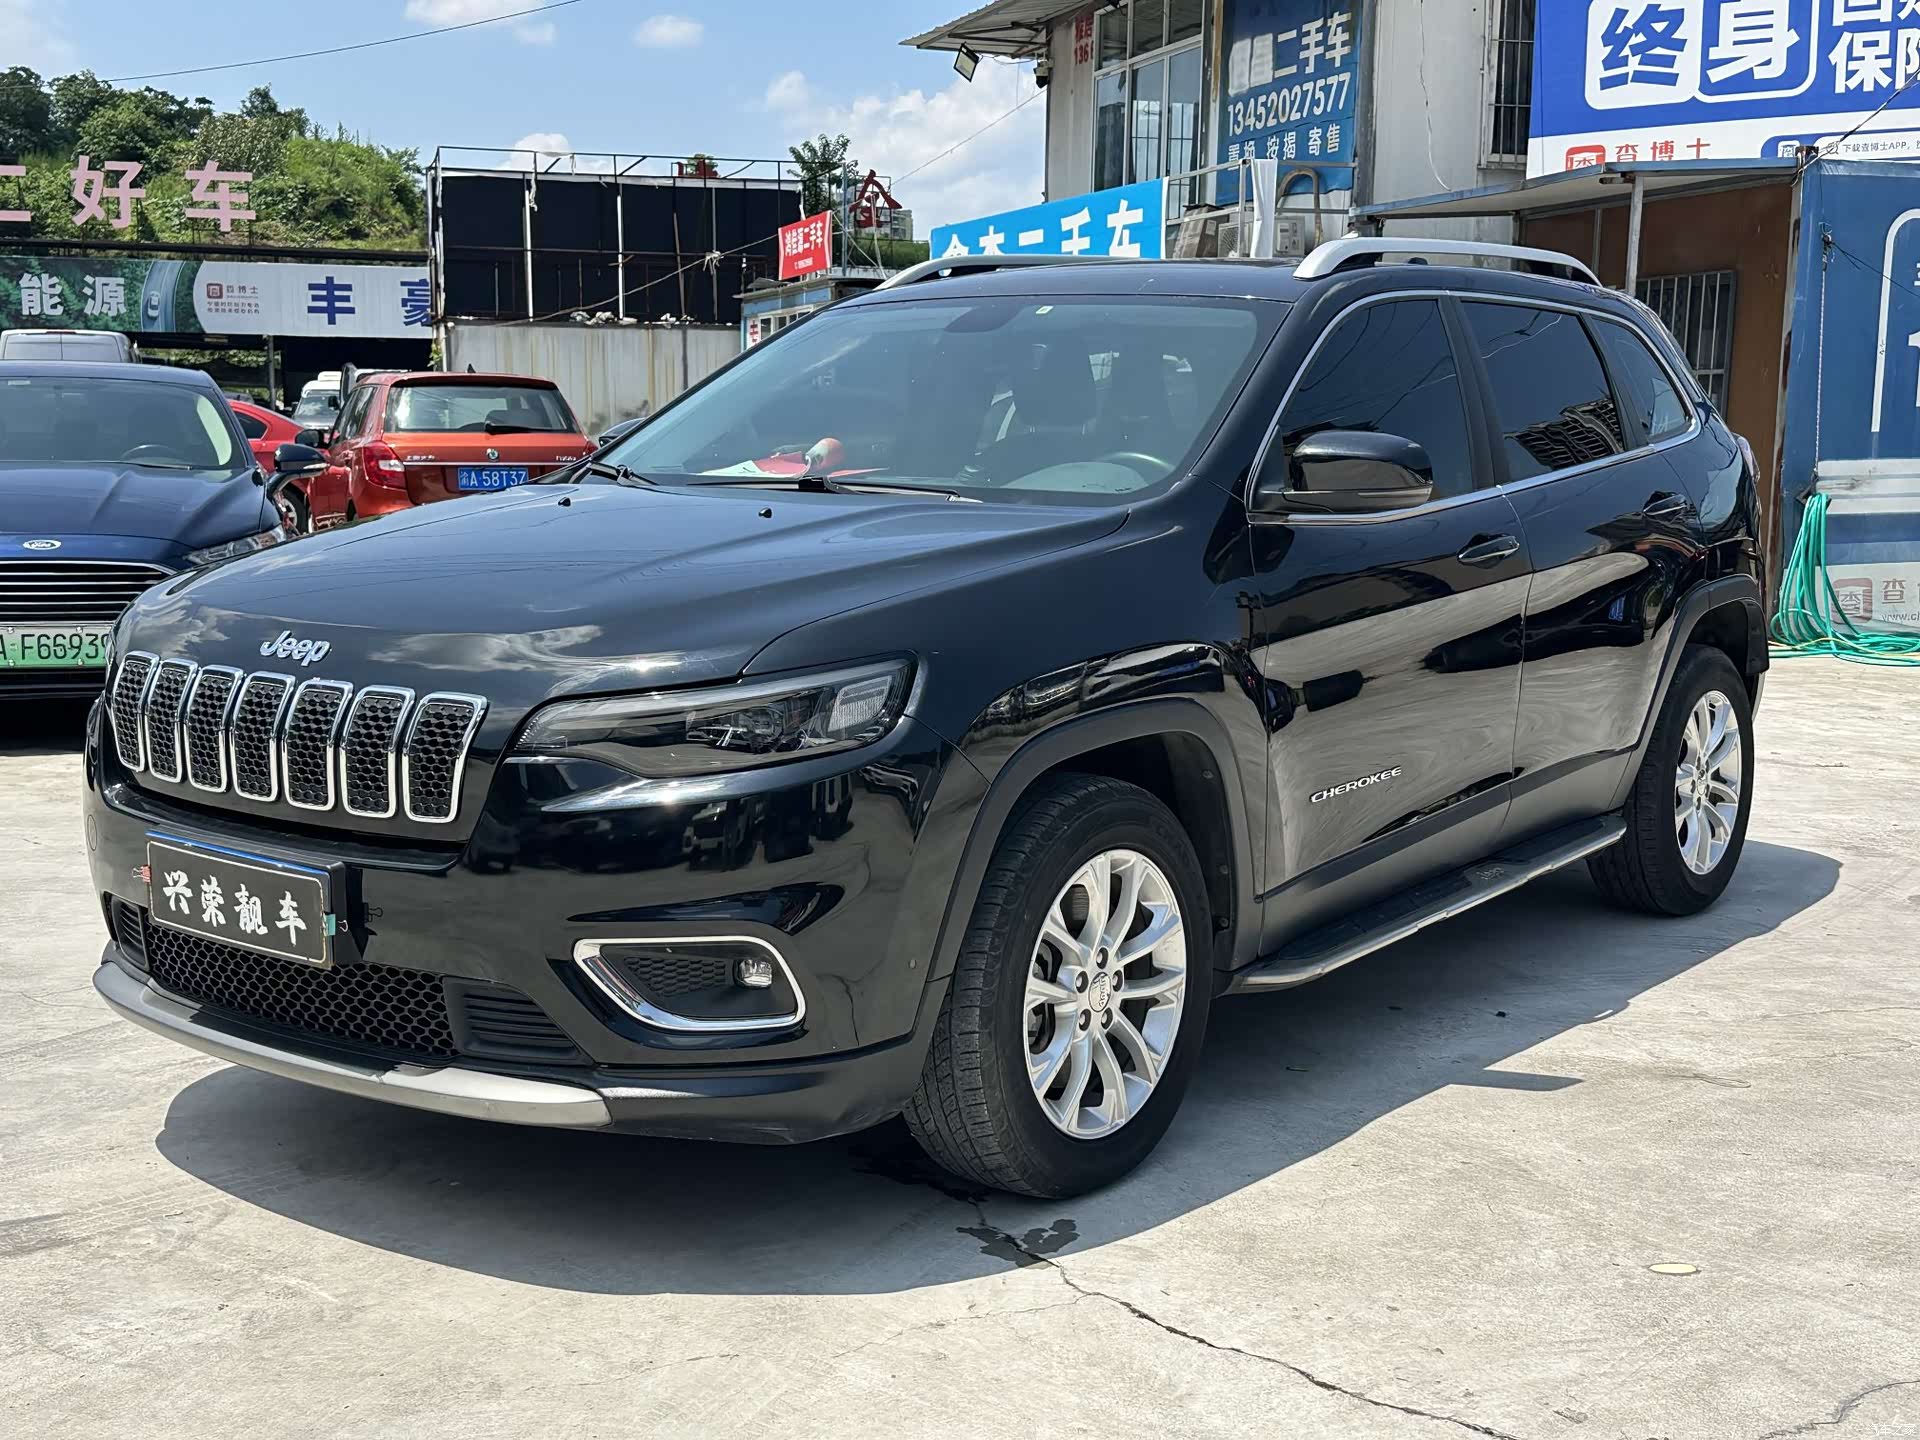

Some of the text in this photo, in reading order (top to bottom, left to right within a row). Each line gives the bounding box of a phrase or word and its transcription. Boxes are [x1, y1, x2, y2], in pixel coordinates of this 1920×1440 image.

[1599, 0, 1800, 91] 终身
[1228, 72, 1351, 137] 13452027577
[1307, 123, 1341, 156] 寄售
[19, 273, 127, 317] 能源
[259, 630, 331, 666] Jeep
[1310, 765, 1402, 803] CHEROKEE
[162, 870, 308, 947] 兴荣靓车
